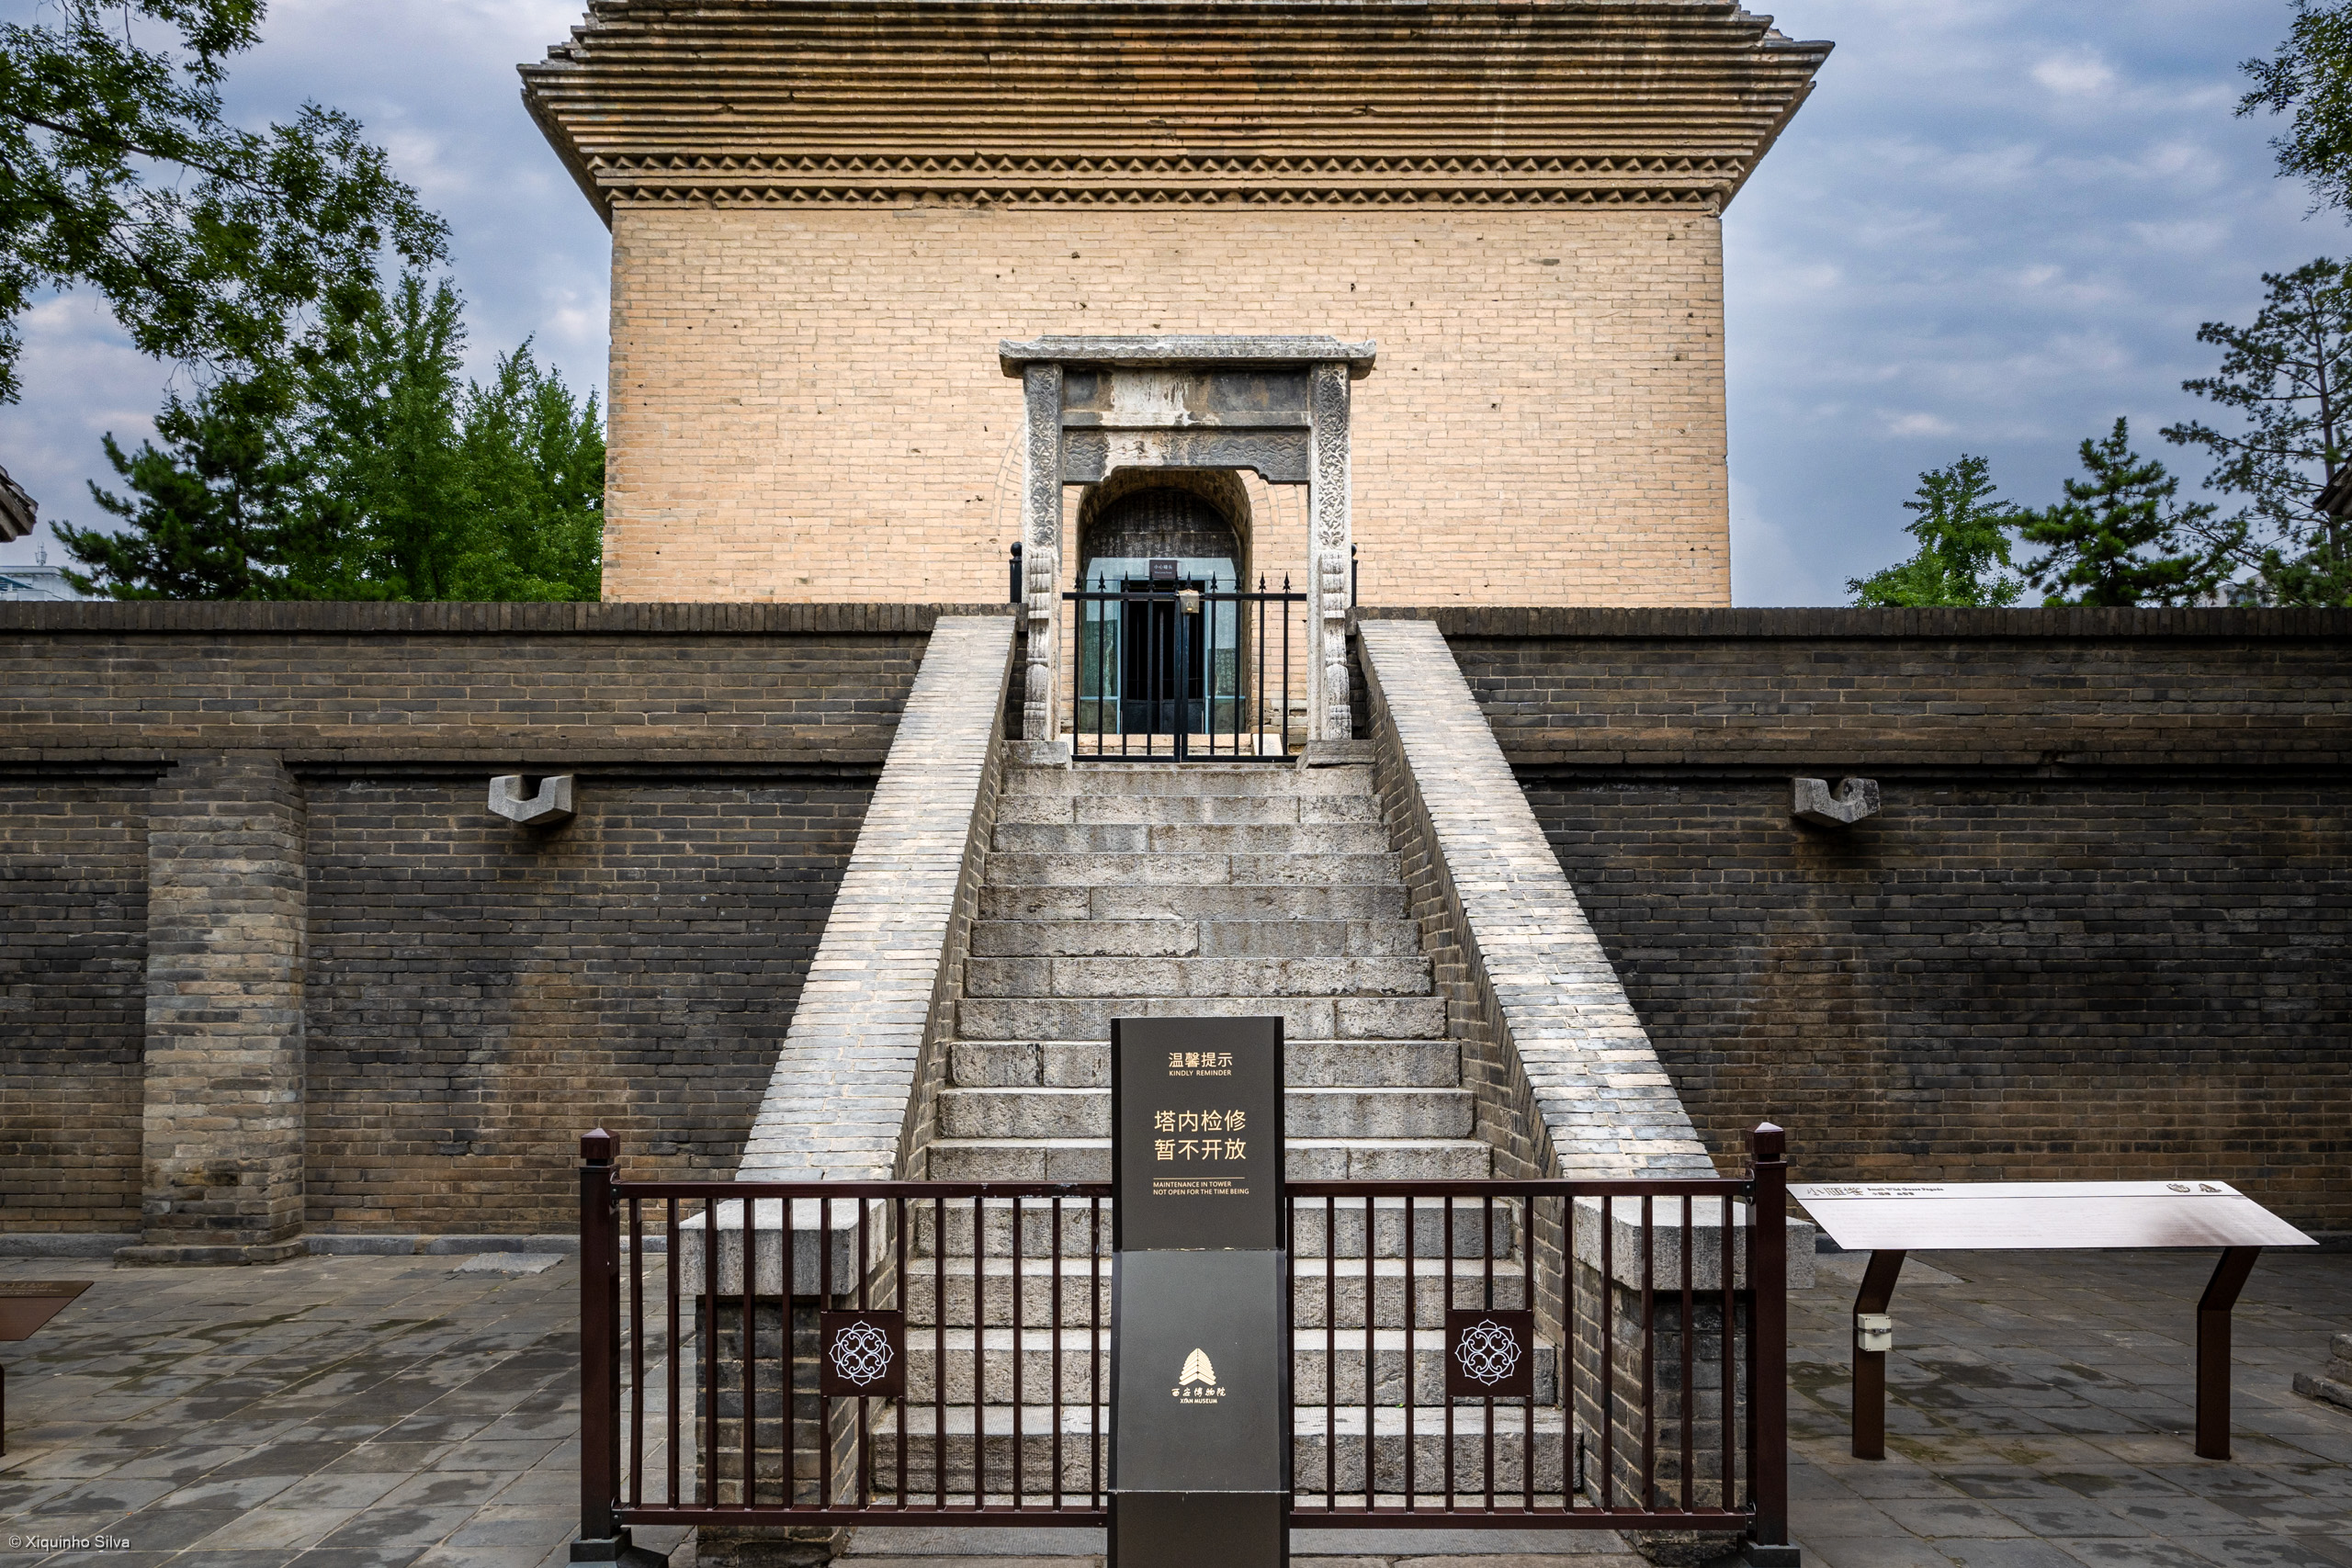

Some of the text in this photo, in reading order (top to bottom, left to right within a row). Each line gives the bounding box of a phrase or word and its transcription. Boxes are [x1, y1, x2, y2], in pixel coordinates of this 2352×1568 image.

[1168, 1052, 1233, 1068] 温馨提示
[1154, 1109, 1246, 1133] 塔内检修
[1154, 1138, 1247, 1160] 暂不开放
[1171, 1387, 1226, 1397] 西安博物院
